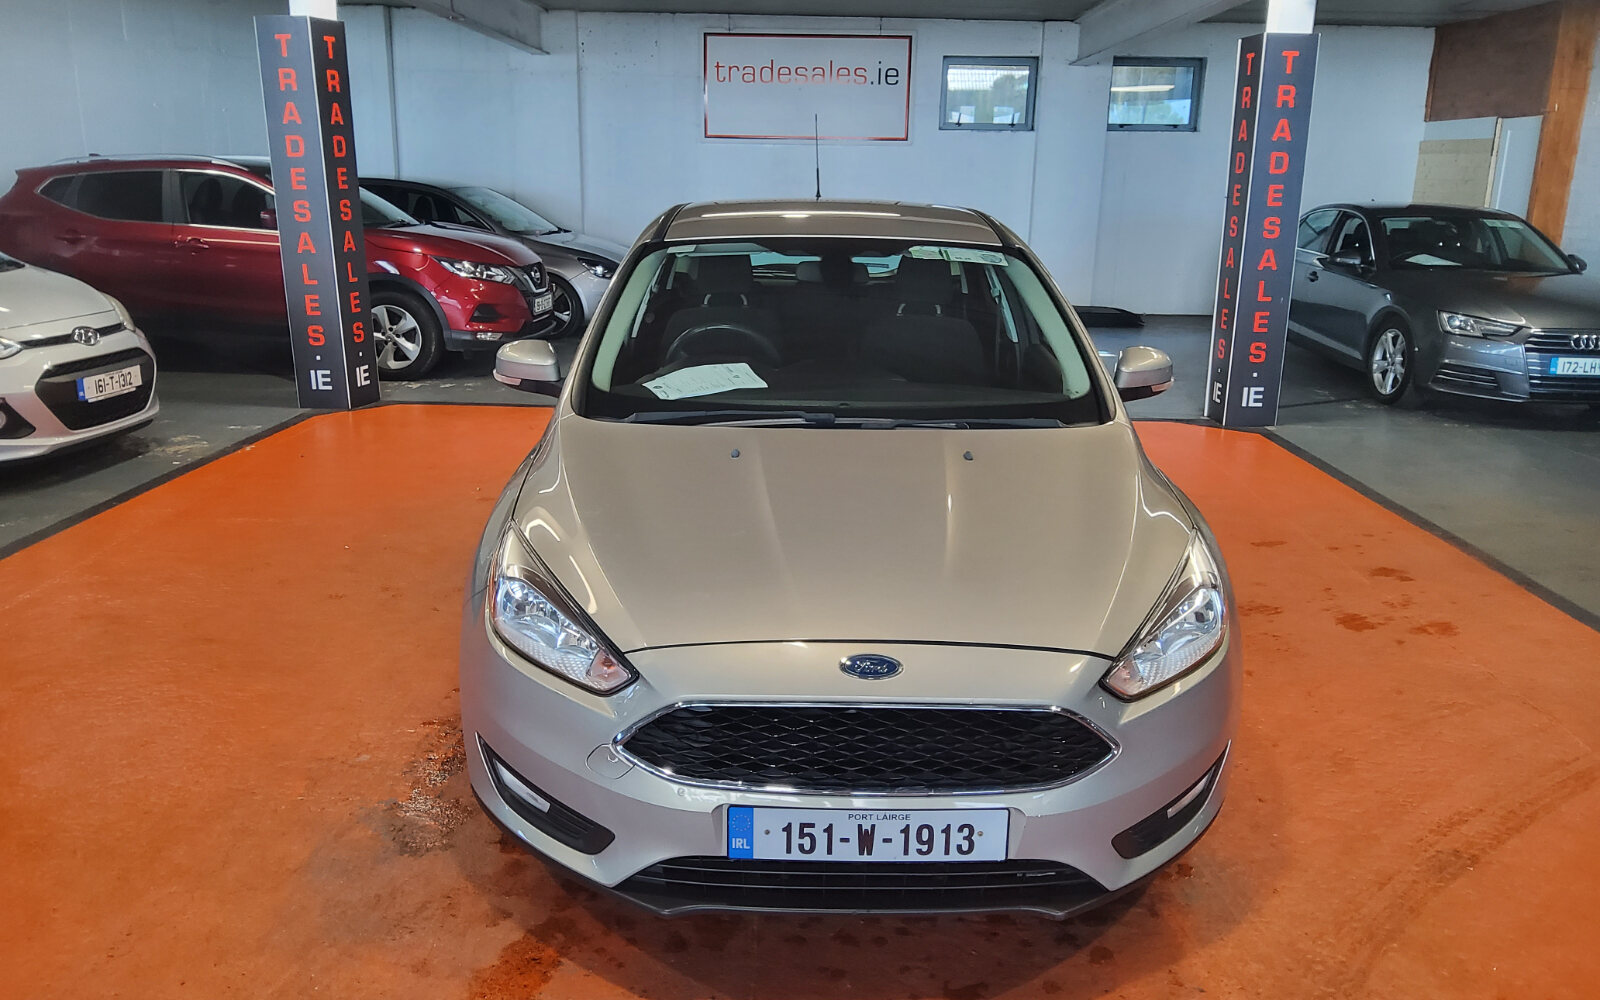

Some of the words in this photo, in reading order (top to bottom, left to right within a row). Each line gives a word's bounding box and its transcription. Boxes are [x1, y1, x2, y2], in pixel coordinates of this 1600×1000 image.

[714, 59, 899, 86] tradesales.ie
[848, 813, 873, 821] PORT
[731, 837, 751, 850] IRL
[781, 822, 976, 856] 151-W-1913
